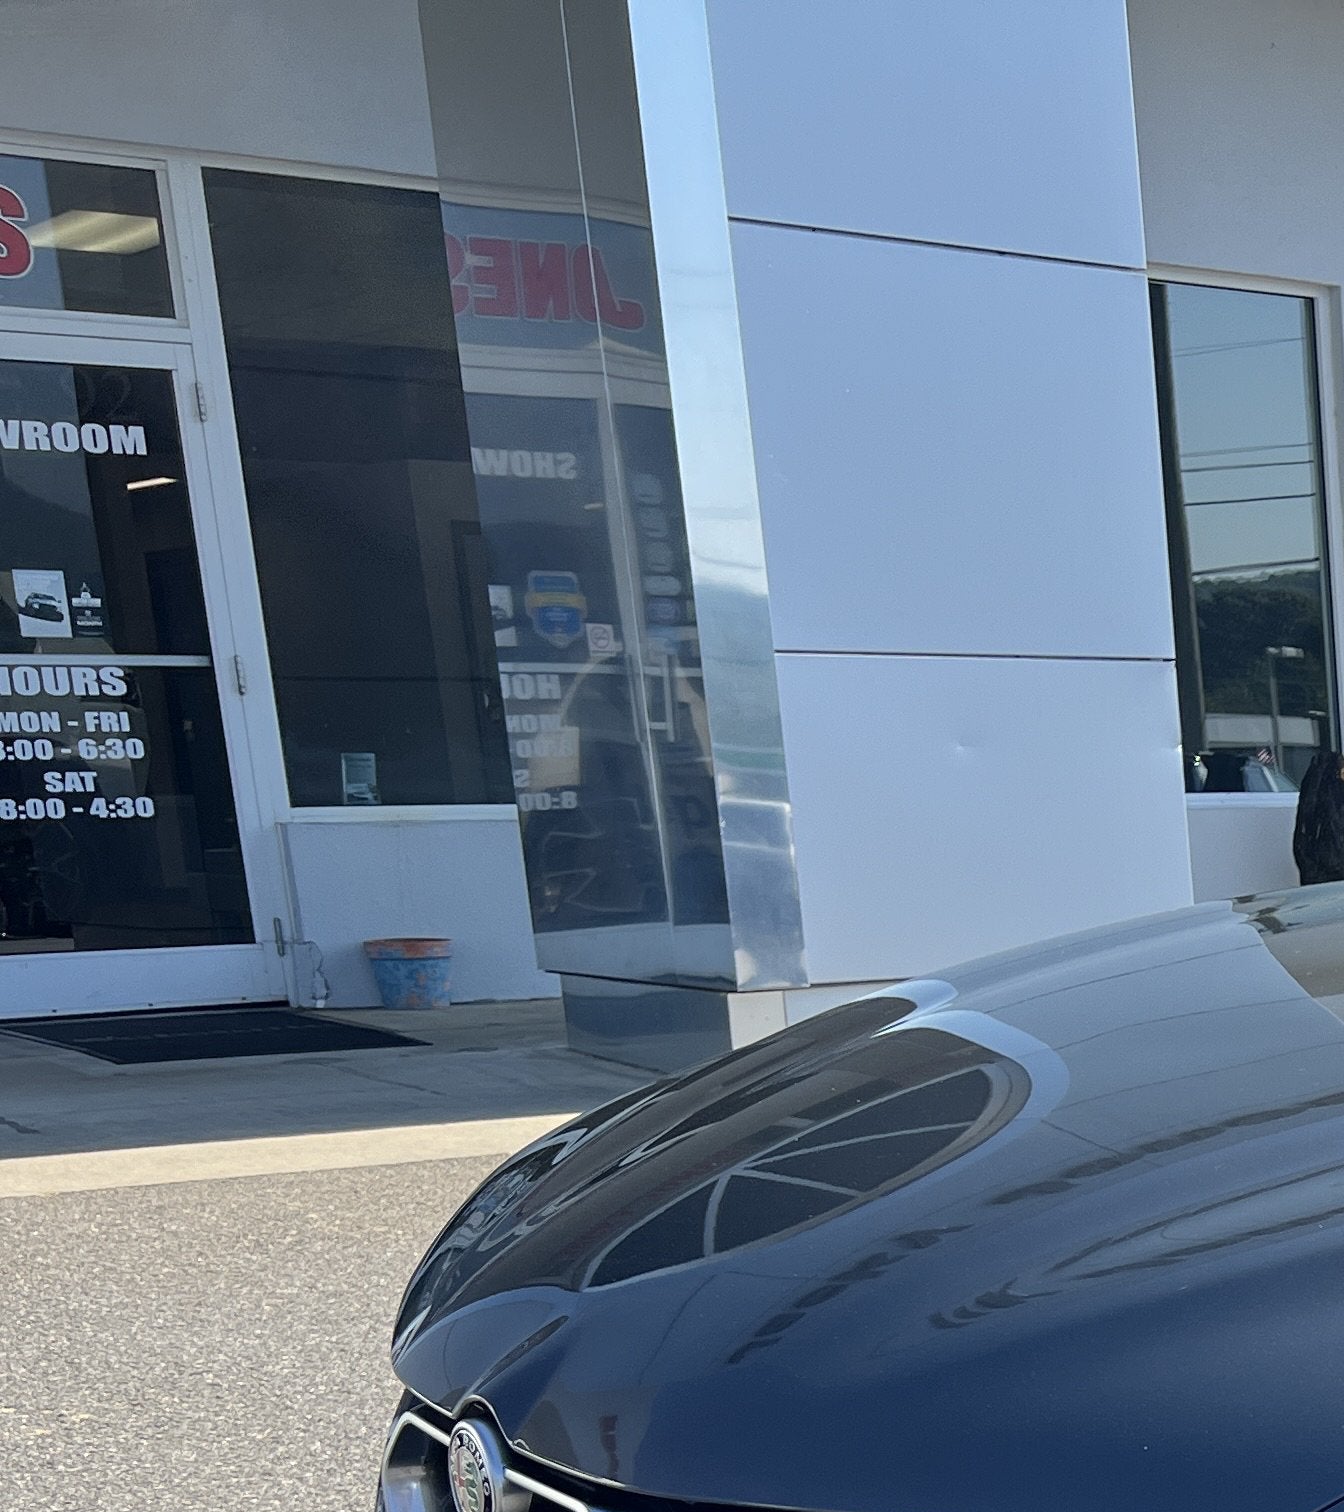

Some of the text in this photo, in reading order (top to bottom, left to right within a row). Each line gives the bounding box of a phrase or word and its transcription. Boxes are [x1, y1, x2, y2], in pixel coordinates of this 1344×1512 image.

[84, 711, 131, 733] FRI
[77, 738, 145, 760] 6:30
[43, 771, 98, 793] SAT
[0, 797, 66, 820] 8:00
[89, 796, 155, 818] 4:30
